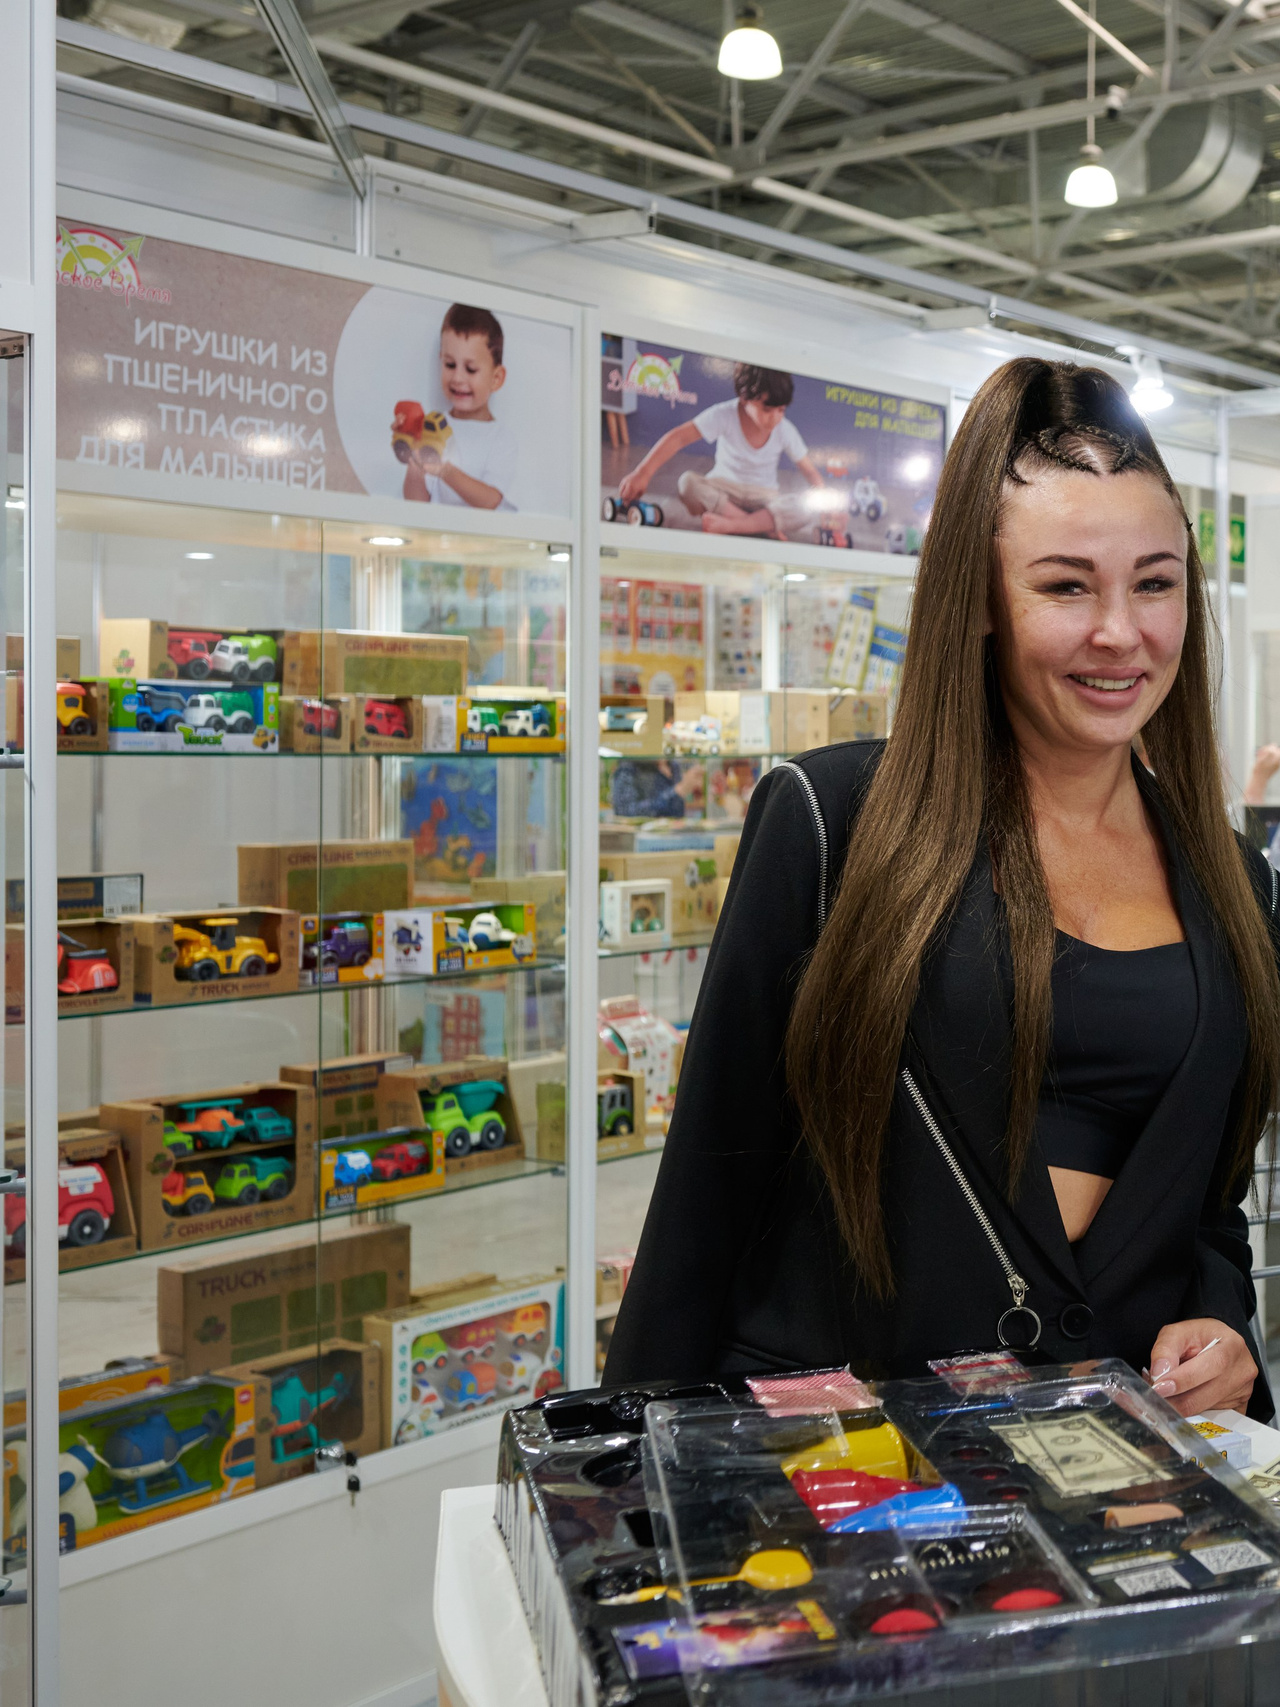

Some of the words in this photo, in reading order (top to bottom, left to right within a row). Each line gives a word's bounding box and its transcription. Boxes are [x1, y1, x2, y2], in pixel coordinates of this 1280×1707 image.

[108, 265, 172, 308] Время
[134, 316, 278, 370] ИГРУШКИ
[290, 345, 328, 378] ИЗ
[103, 352, 328, 415] ПШЕНИЧНОГО
[157, 402, 327, 454] ПЛАСТИКА
[75, 434, 146, 470] ДЛЯ
[159, 444, 326, 492] МАЛЫШЕЙ
[198, 1267, 267, 1299] TRUCK
